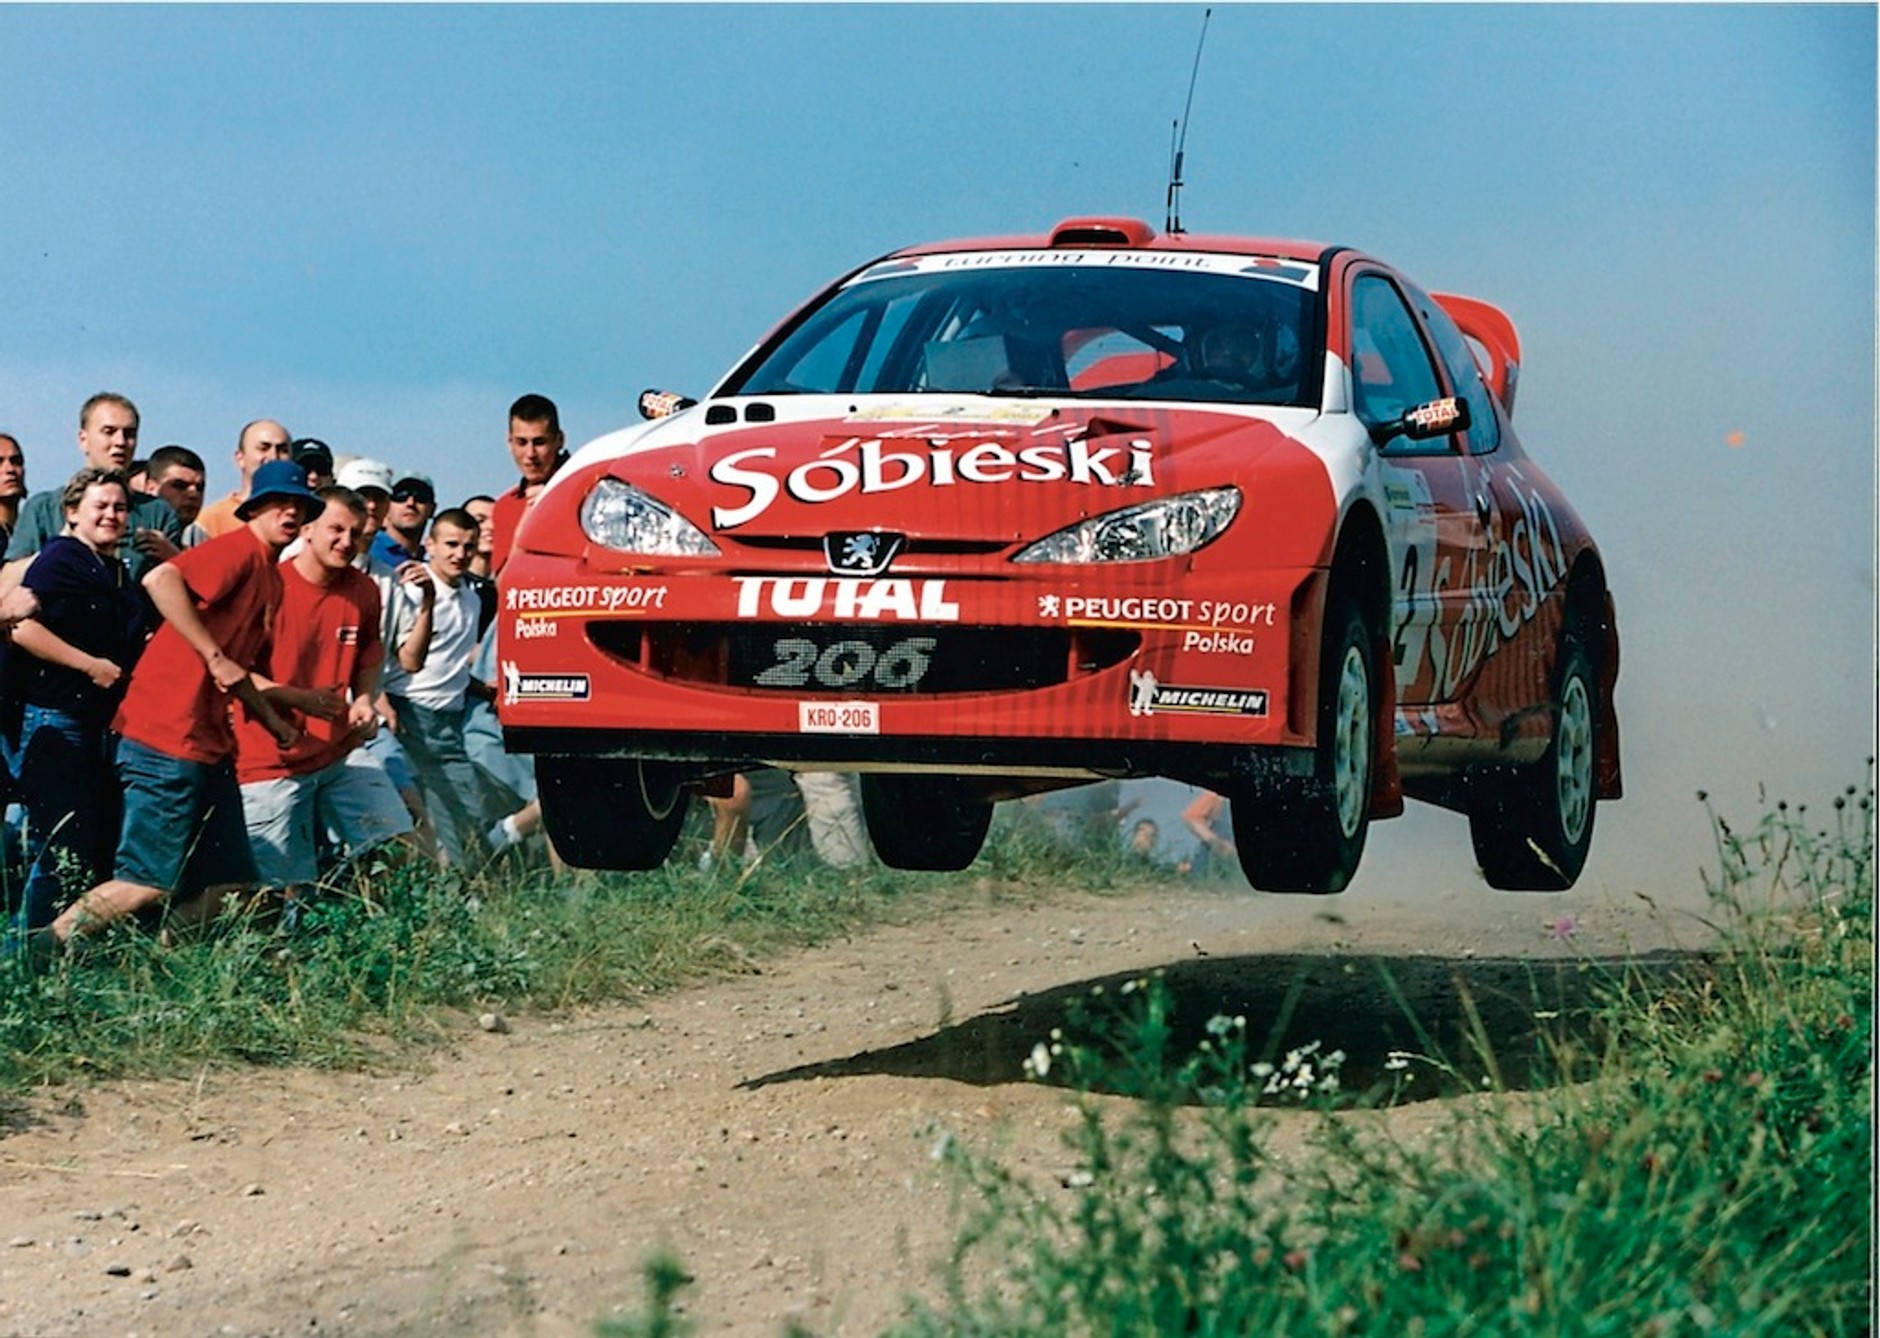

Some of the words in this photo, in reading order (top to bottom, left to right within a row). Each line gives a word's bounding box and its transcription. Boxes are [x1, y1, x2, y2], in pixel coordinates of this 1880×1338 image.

[944, 253, 1085, 266] turning
[1107, 253, 1210, 268] point
[1416, 406, 1458, 422] TOTAL
[518, 586, 599, 608] PEUGEOT
[600, 586, 668, 612] sport
[732, 576, 959, 620] TOTAL
[1065, 598, 1194, 619] PEUGEOT
[1197, 600, 1276, 627] sport
[515, 618, 557, 639] Polska
[1183, 632, 1255, 654] Polska
[753, 637, 937, 687] 206
[521, 679, 587, 693] MICHELIN
[1159, 689, 1263, 710] MICHELIN
